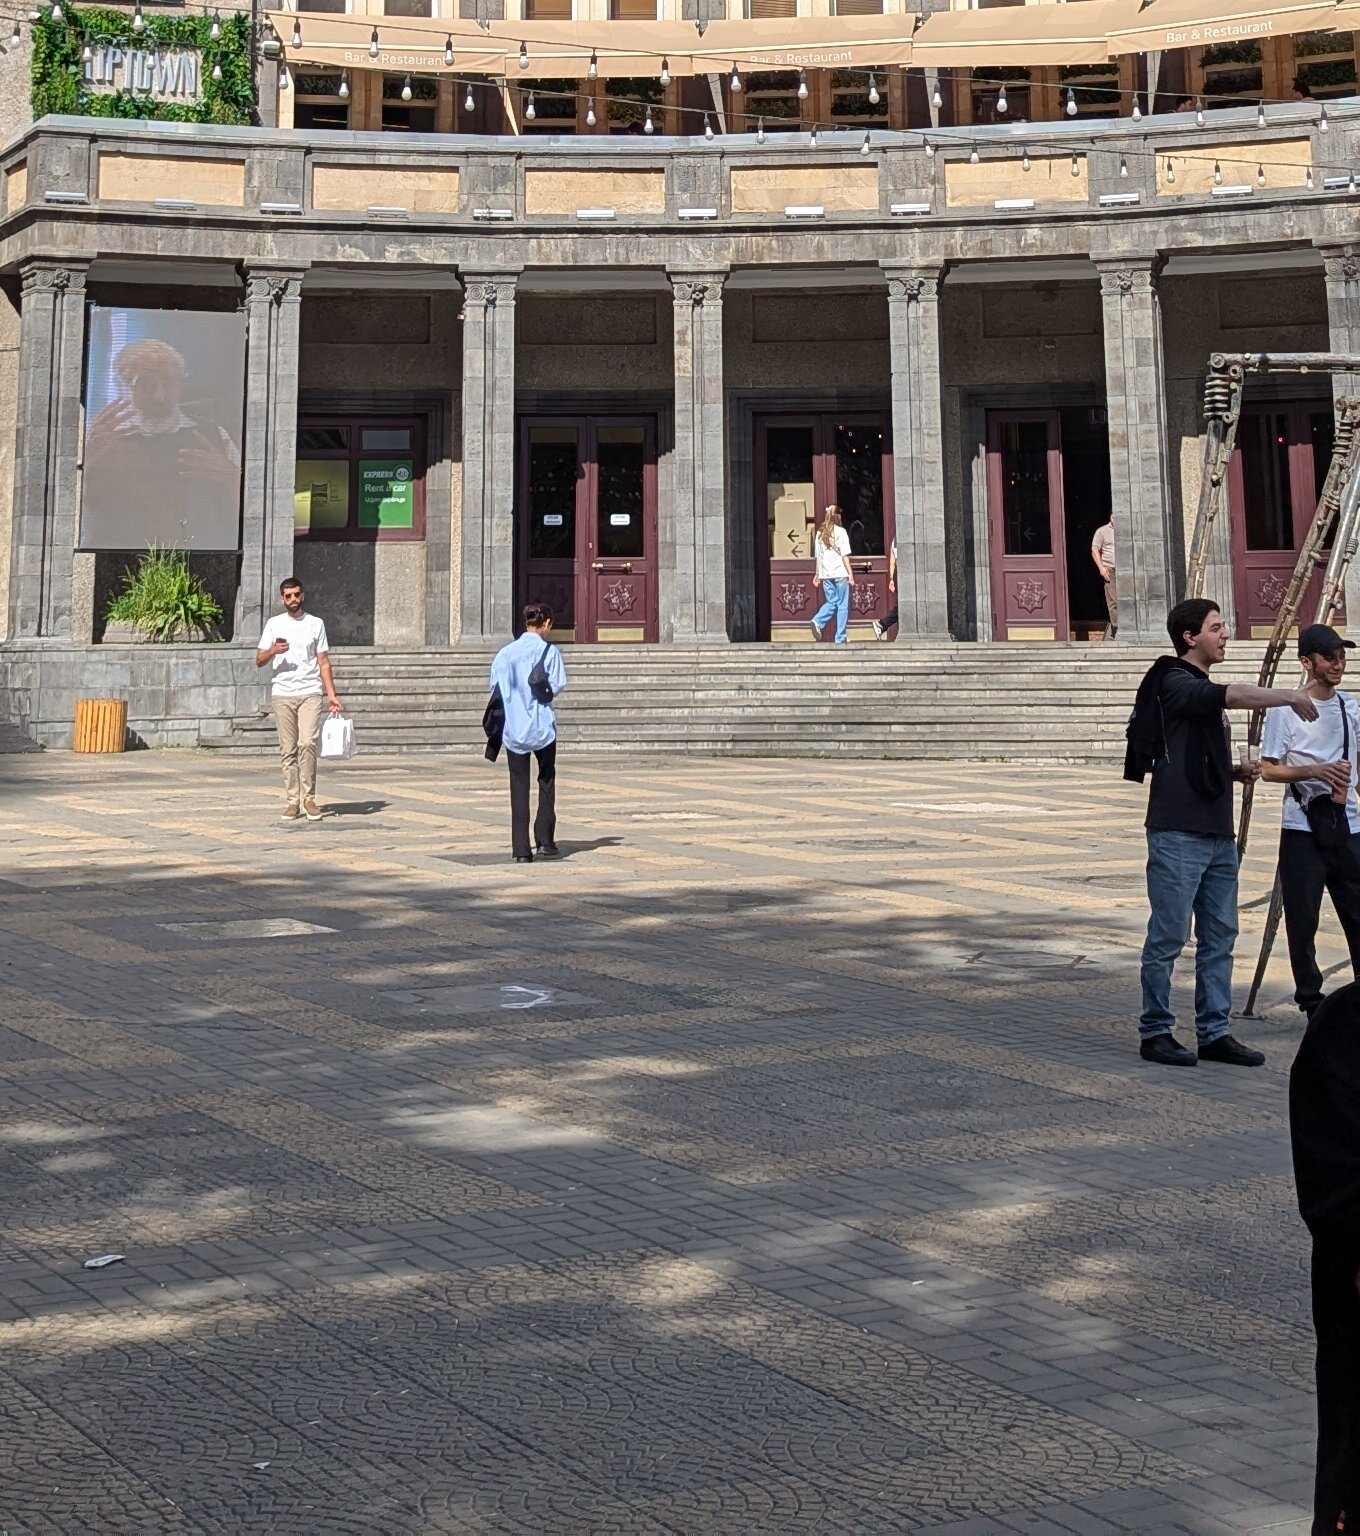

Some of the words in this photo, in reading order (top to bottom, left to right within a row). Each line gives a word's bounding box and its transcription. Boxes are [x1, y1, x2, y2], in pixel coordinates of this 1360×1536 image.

[1166, 32, 1187, 44] Bar
[1190, 29, 1201, 40] &
[1204, 19, 1273, 38] Restaurant
[344, 52, 365, 63] Bar
[381, 53, 446, 66] Restaurant
[774, 54, 783, 64] &
[786, 51, 853, 64] Restaurant
[84, 46, 198, 94] UPTOWN
[364, 484, 384, 492] Rent
